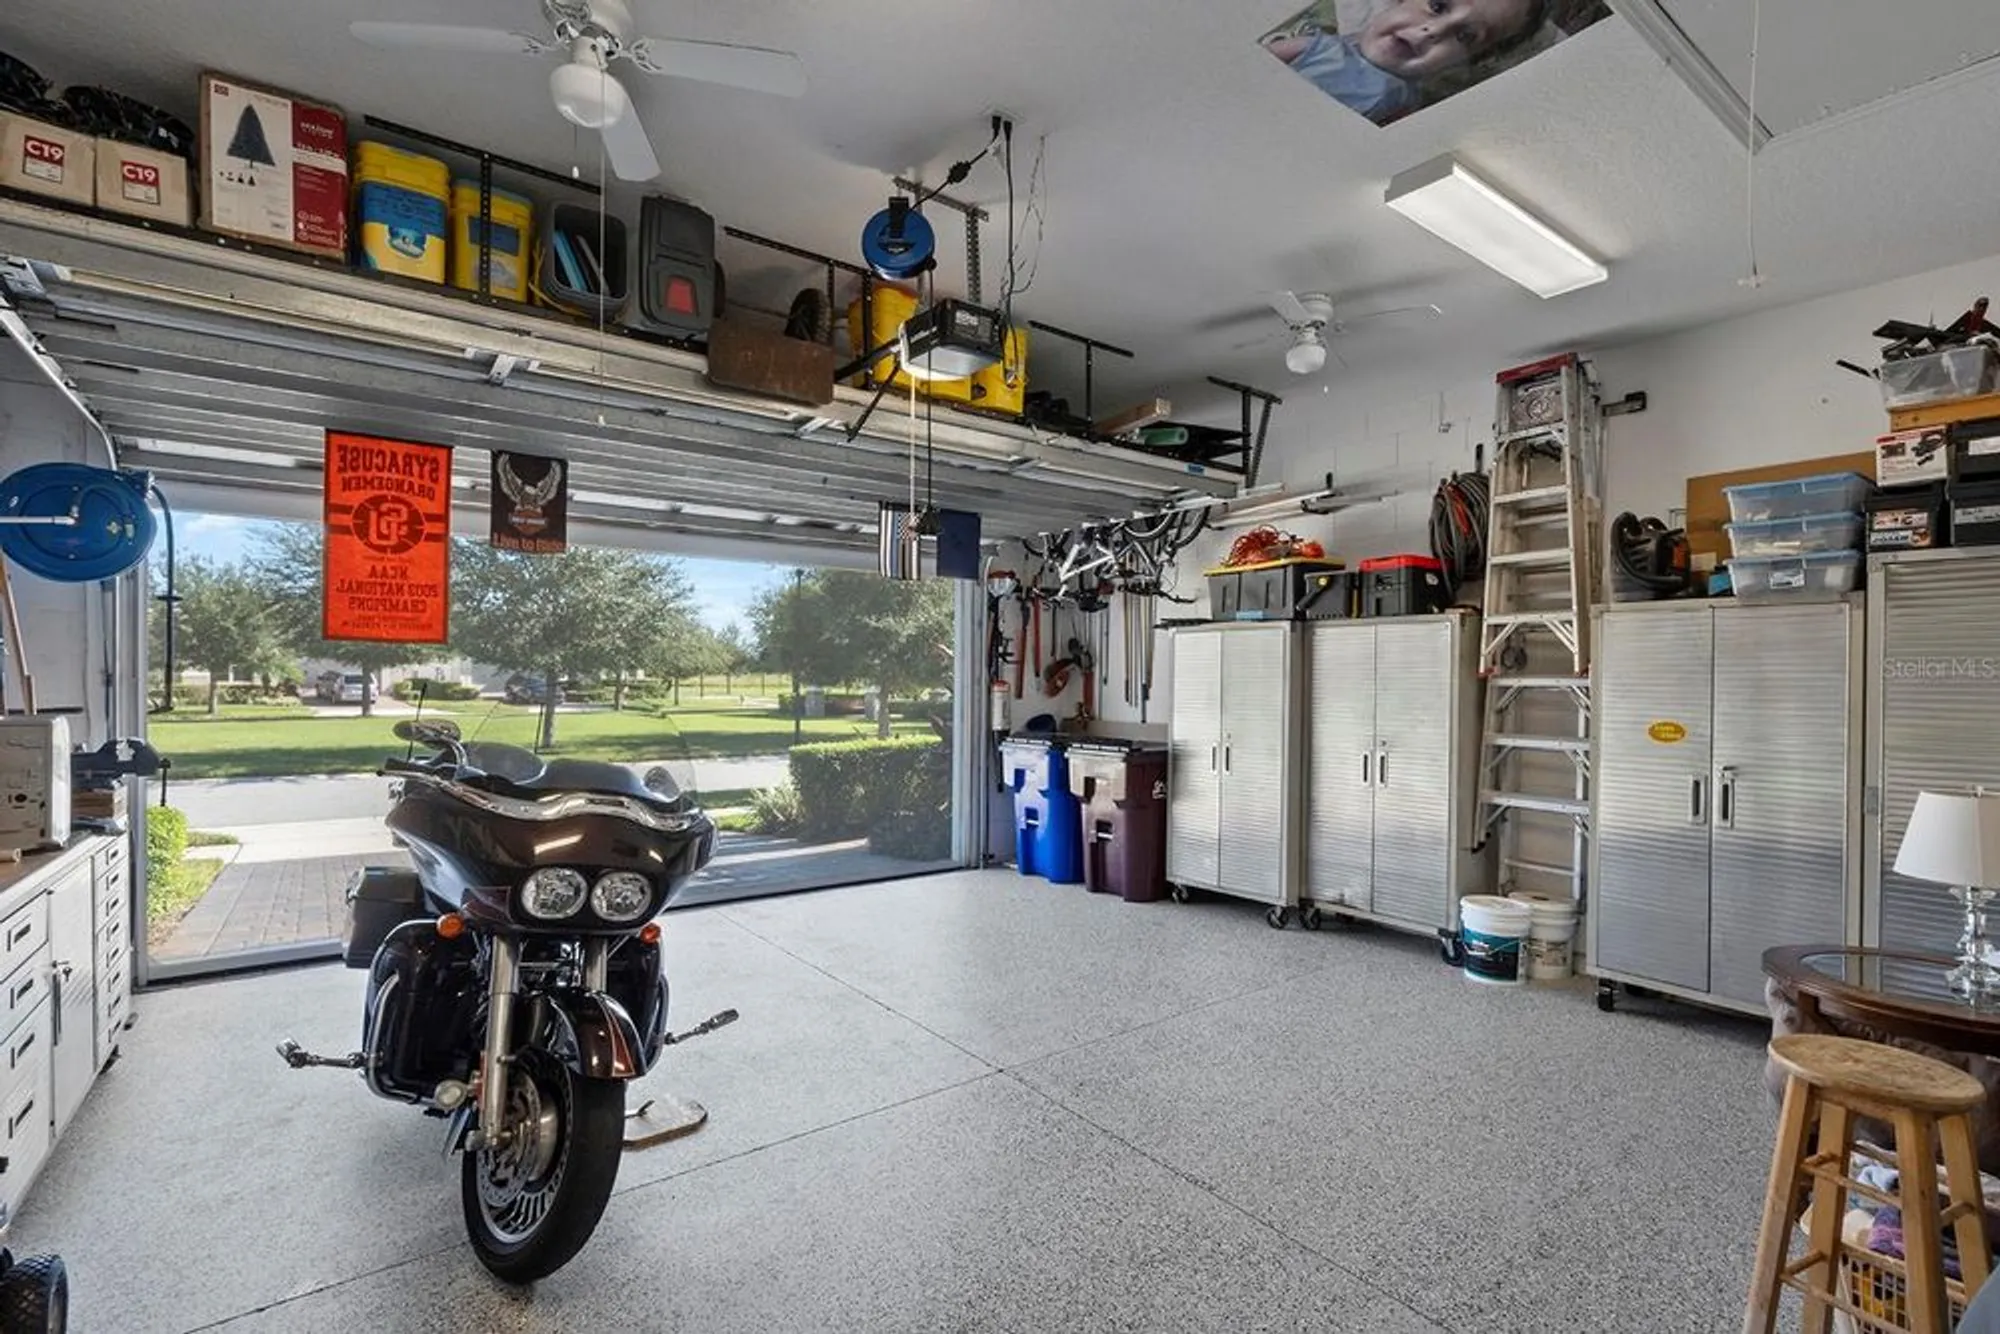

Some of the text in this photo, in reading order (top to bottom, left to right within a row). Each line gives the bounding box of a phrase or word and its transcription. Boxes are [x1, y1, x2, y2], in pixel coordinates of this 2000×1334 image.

[26, 140, 64, 161] C19
[122, 164, 156, 183] C19
[522, 538, 535, 550] to
